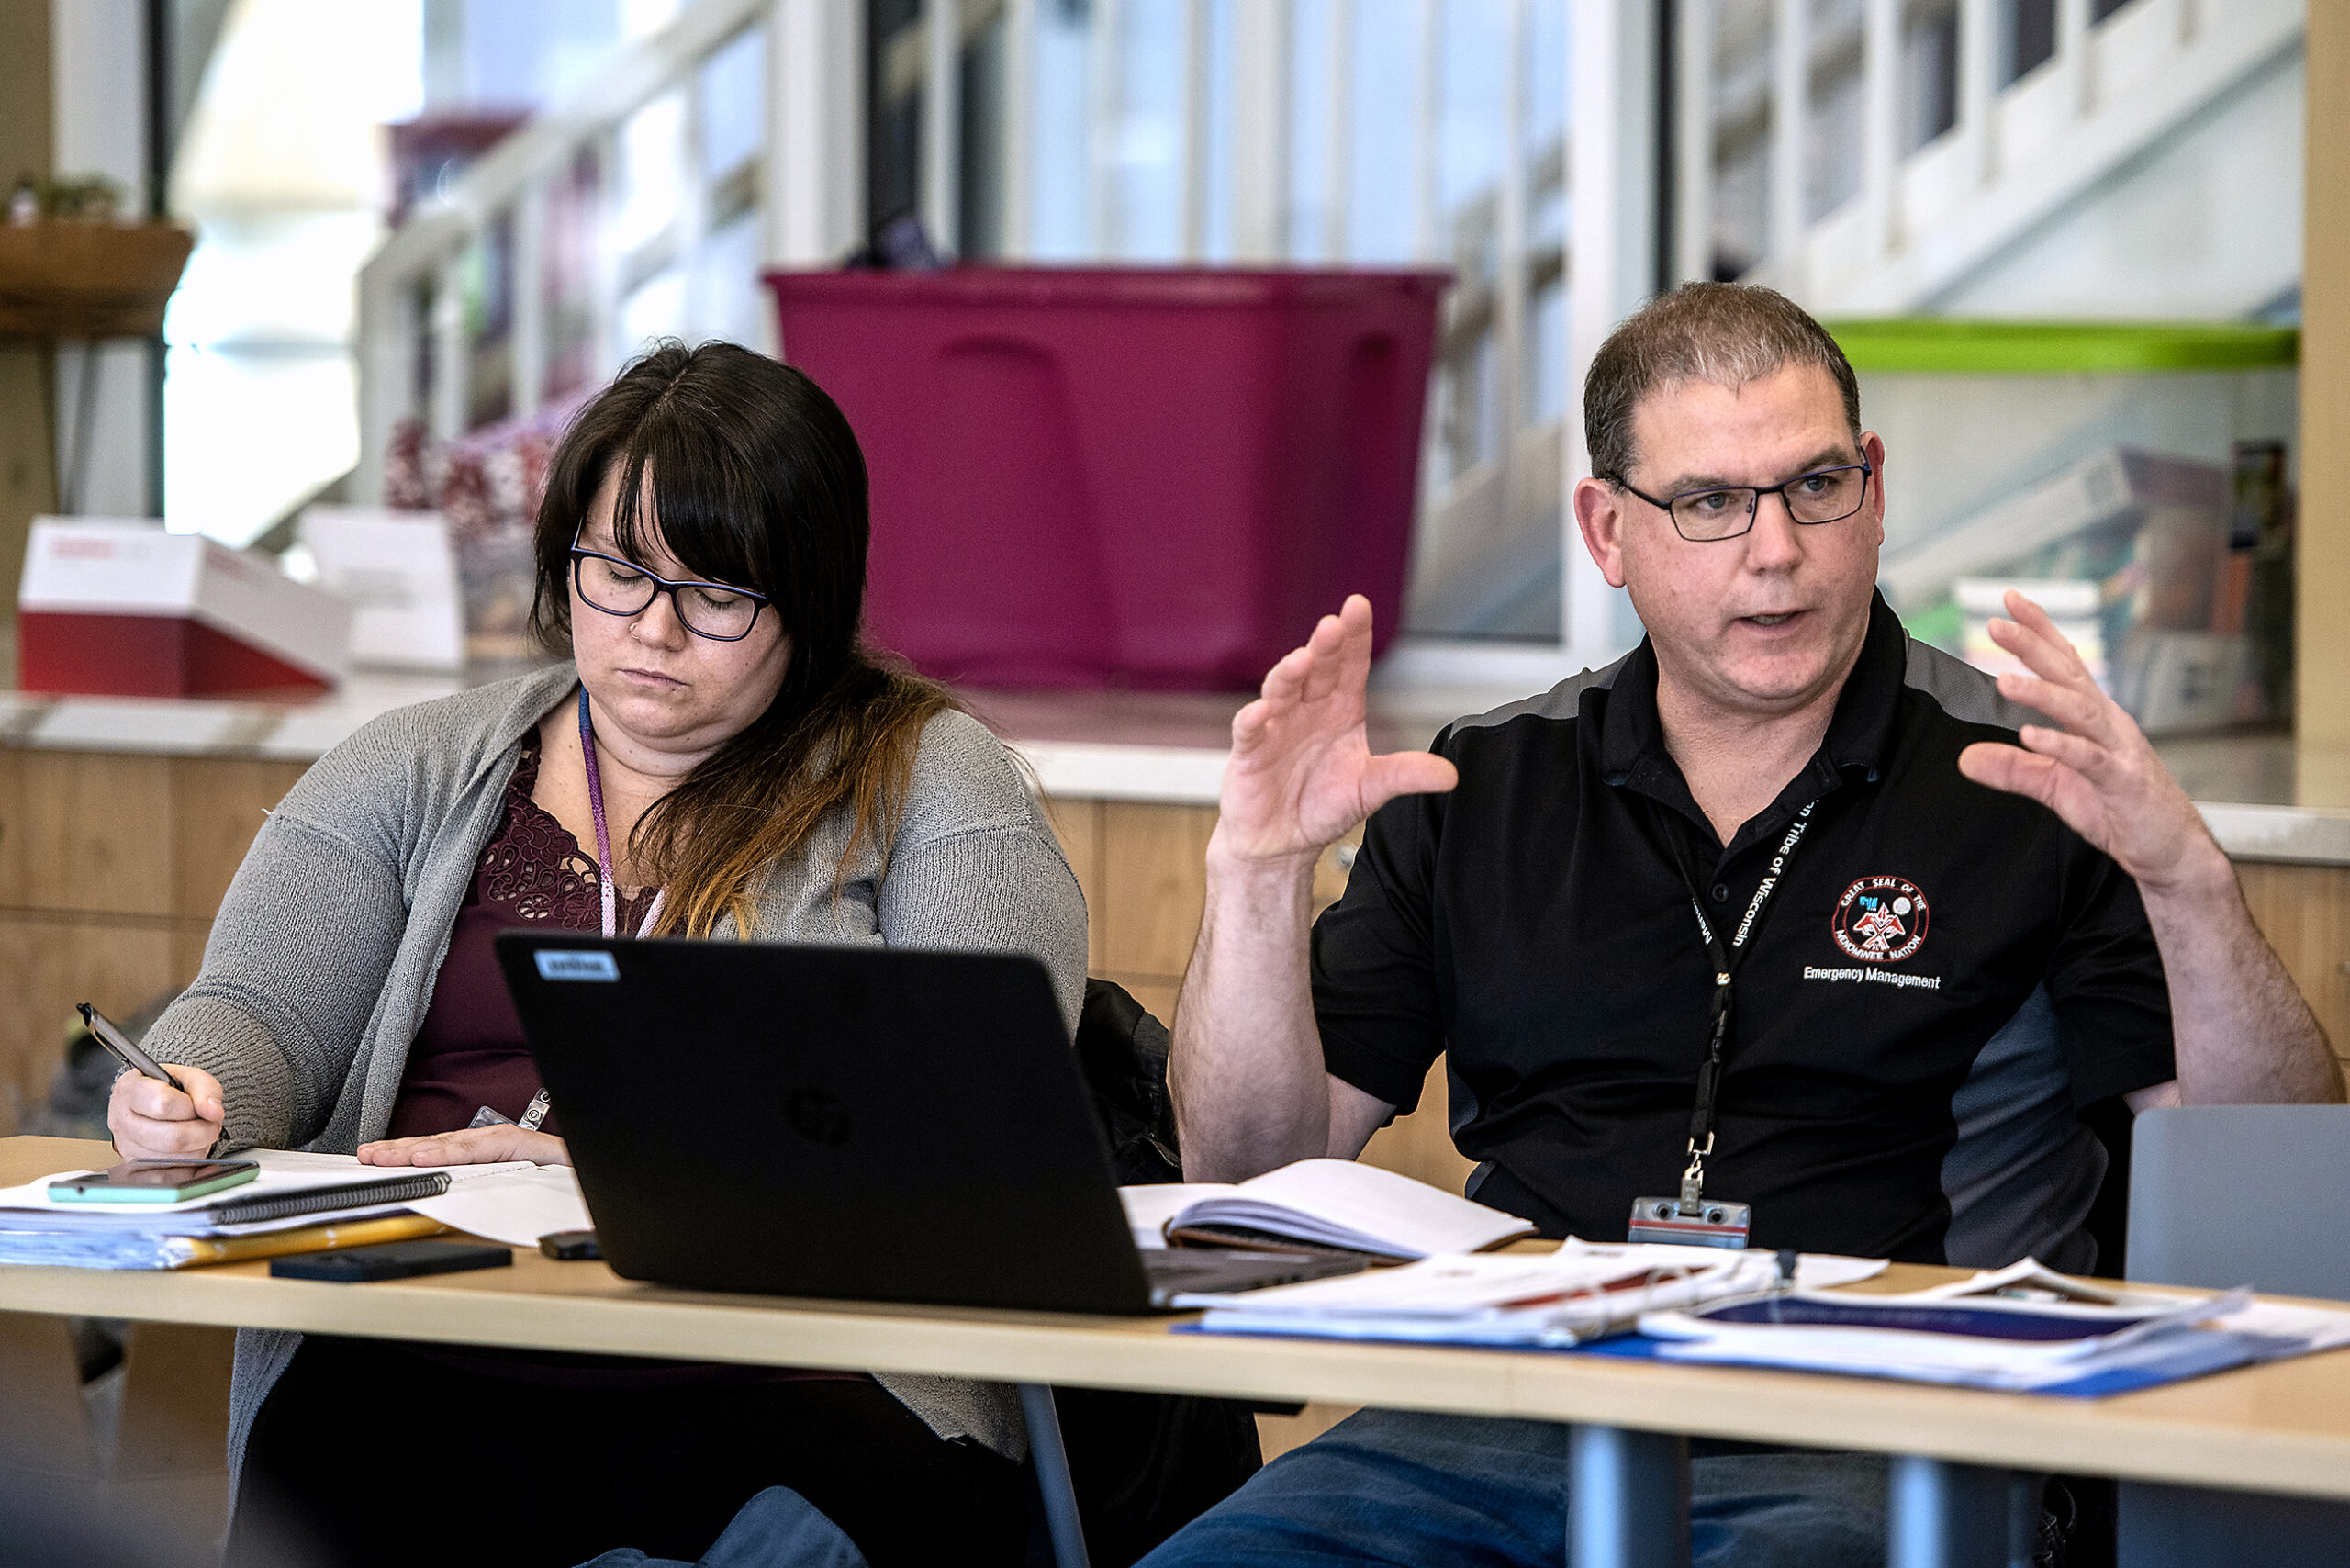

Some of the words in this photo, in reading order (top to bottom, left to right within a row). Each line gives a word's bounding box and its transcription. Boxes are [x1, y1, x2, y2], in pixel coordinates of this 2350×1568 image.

[1779, 822, 1807, 855] Tribe
[1769, 857, 1784, 875] of
[1840, 881, 1865, 907] GREAT
[1872, 877, 1897, 889] SEAL
[1900, 883, 1915, 893] OF
[1913, 893, 1927, 912] THE
[1732, 878, 1777, 946] Wisconsin
[1835, 929, 1885, 961] MENOMINEE
[1888, 935, 1922, 960] NATION
[1803, 966, 1864, 983] Emergency
[1864, 966, 1942, 990] Management
